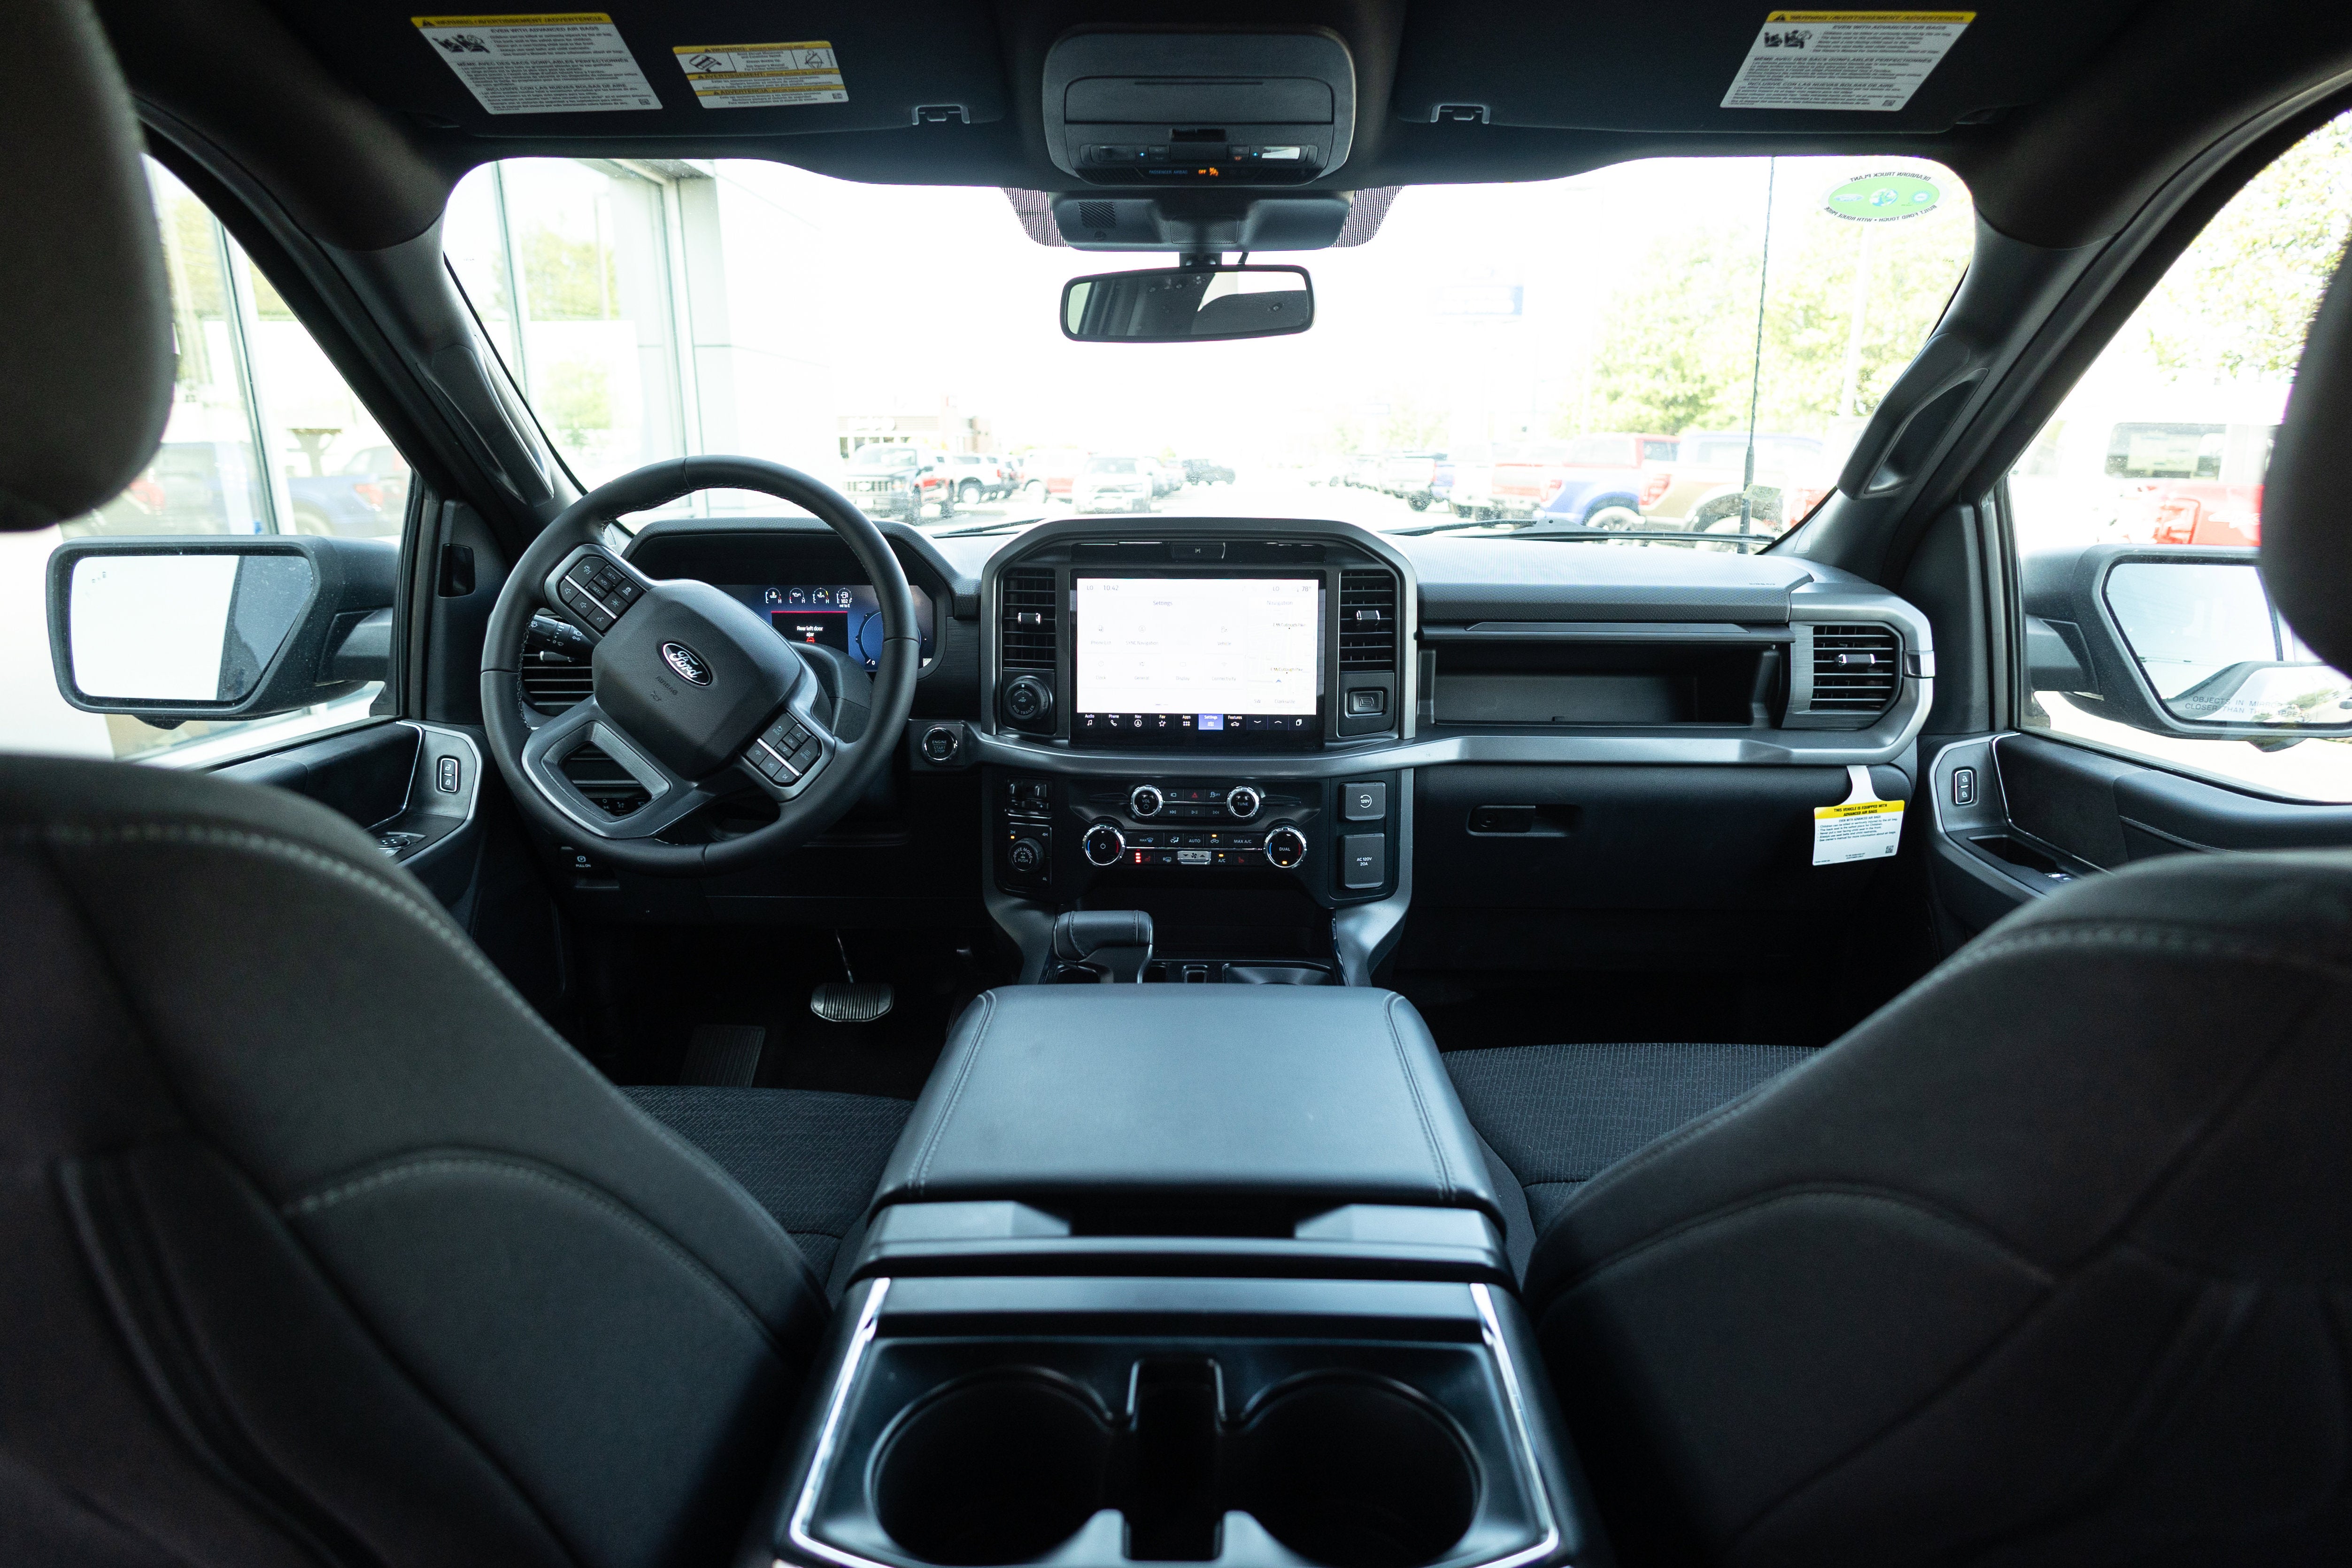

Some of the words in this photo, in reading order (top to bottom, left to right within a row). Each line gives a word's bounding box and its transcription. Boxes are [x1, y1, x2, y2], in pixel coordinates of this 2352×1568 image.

[669, 651, 702, 678] Ford
[2192, 696, 2230, 705] OBJECTS
[1021, 705, 1034, 715] TRAILER
[1013, 847, 1022, 857] DRIVE
[1023, 848, 1033, 858] MODE
